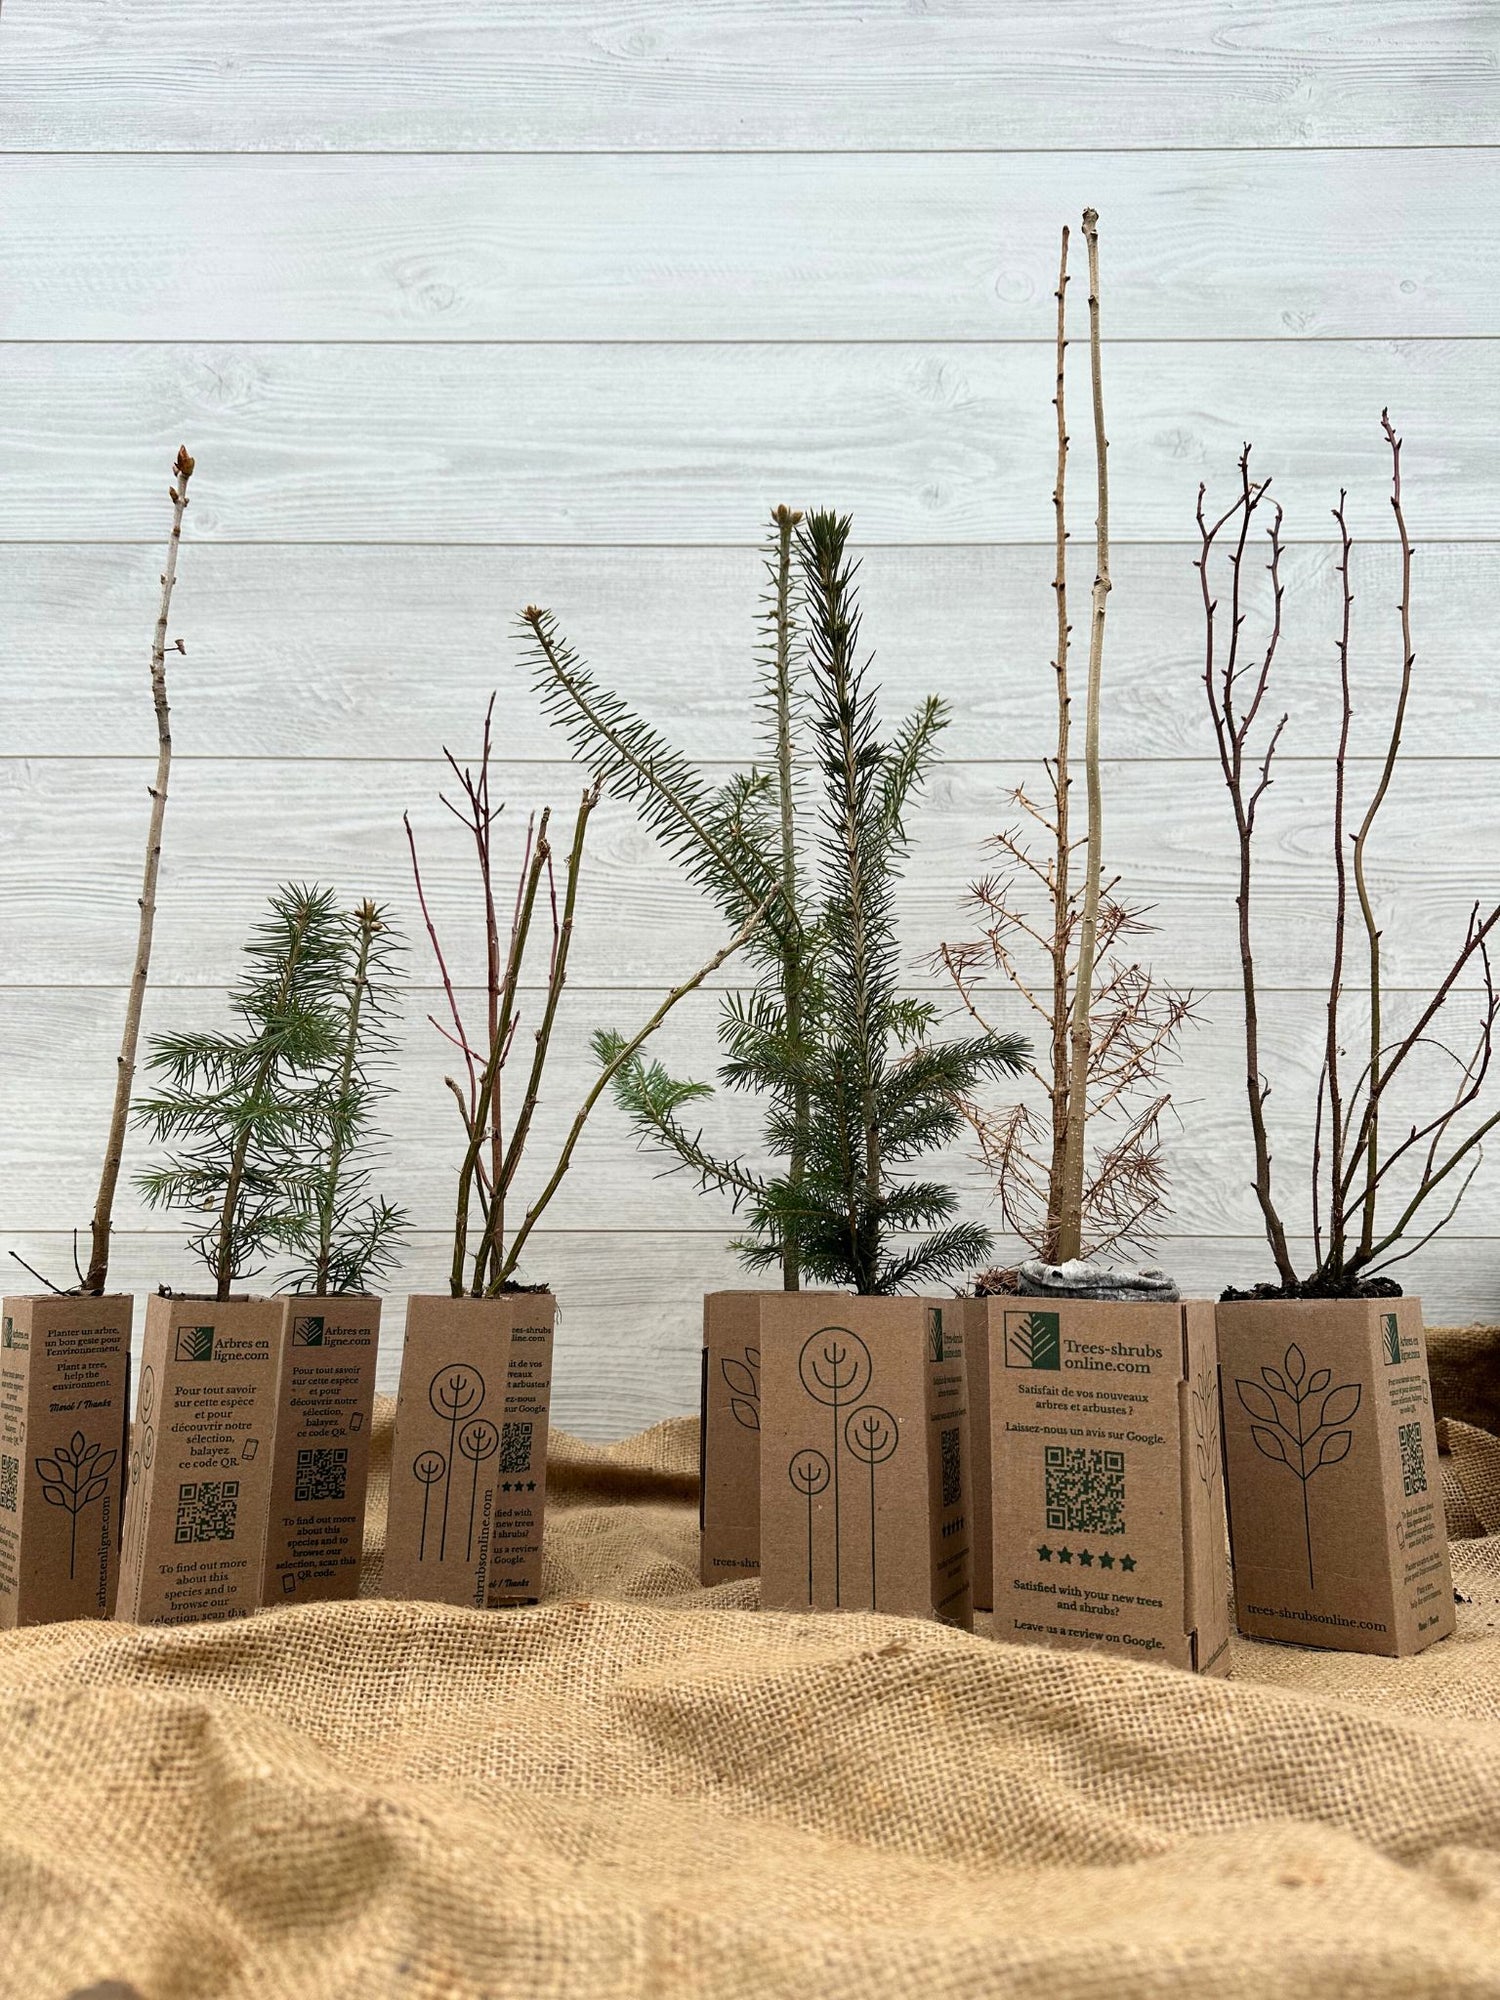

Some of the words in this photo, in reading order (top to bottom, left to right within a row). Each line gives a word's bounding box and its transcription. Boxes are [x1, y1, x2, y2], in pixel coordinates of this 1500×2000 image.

[47, 1329, 80, 1338] Planter
[324, 1327, 357, 1336] Arbres
[358, 1328, 371, 1336] en
[78, 1338, 100, 1347] geste
[100, 1337, 122, 1345] pour
[214, 1338, 253, 1349] Arbres
[255, 1340, 269, 1348] en
[323, 1337, 371, 1348] ligne.com
[1064, 1339, 1163, 1359] Trees-shrubs
[213, 1350, 269, 1363] ligne.com
[57, 1363, 80, 1371] Plant
[292, 1367, 314, 1375] Pour
[315, 1367, 333, 1375] tout
[334, 1366, 361, 1374] savoir
[1065, 1357, 1151, 1374] online.com
[64, 1372, 84, 1381] help
[85, 1371, 100, 1379] the
[330, 1377, 359, 1386] espèce
[174, 1386, 201, 1396] Pour
[203, 1386, 225, 1395] tout
[226, 1384, 257, 1394] savoir
[309, 1388, 318, 1396] et
[319, 1388, 342, 1397] pour
[1018, 1384, 1059, 1397] Satisfait
[1061, 1387, 1074, 1397] de
[1076, 1390, 1094, 1399] vos
[1096, 1390, 1149, 1403] nouveaux
[84, 1399, 112, 1409] Thanks
[174, 1399, 192, 1407] sur
[194, 1398, 218, 1407] cette
[221, 1397, 254, 1408] espèce
[290, 1398, 332, 1407] découvrir
[1036, 1399, 1068, 1411] arbres
[1070, 1403, 1081, 1412] et
[1082, 1402, 1127, 1415] arbustes
[302, 1407, 344, 1416] sélection,
[519, 1405, 547, 1414] Google.
[206, 1411, 233, 1421] pour
[171, 1422, 223, 1433] découvrir
[225, 1422, 252, 1431] notre
[305, 1419, 339, 1427] balayez
[308, 1428, 330, 1437] code
[1005, 1421, 1068, 1436] Laissez-nous
[1070, 1427, 1084, 1436] un
[1086, 1427, 1106, 1439] avis
[1108, 1431, 1125, 1440] sur
[1126, 1431, 1166, 1446] Google.
[186, 1434, 235, 1444] sélection,
[190, 1446, 230, 1457] balayez
[178, 1461, 191, 1469] ce
[192, 1458, 218, 1468] code
[221, 1458, 240, 1469] QR.
[282, 1517, 295, 1526] To
[296, 1516, 315, 1525] find
[316, 1516, 332, 1524] out
[297, 1527, 323, 1536] about
[324, 1525, 341, 1534] this
[498, 1530, 529, 1538] shrubs?
[288, 1537, 319, 1549] species
[321, 1536, 338, 1545] and
[96, 1496, 111, 1608] arbresenligne.com
[292, 1549, 325, 1558] browse
[326, 1548, 342, 1556] our
[511, 1544, 538, 1553] review
[275, 1560, 318, 1570] selection,
[319, 1559, 339, 1567] scan
[340, 1556, 356, 1565] this
[495, 1555, 526, 1565] Google.
[159, 1565, 174, 1574] To
[176, 1562, 197, 1573] find
[199, 1562, 218, 1571] out
[219, 1560, 248, 1568] more
[176, 1575, 206, 1586] about
[209, 1572, 229, 1582] this
[297, 1570, 312, 1580] QR
[313, 1568, 336, 1577] code.
[505, 1579, 530, 1587] Thanks
[164, 1587, 202, 1600] species
[204, 1584, 225, 1596] and
[227, 1585, 237, 1593] to
[1013, 1580, 1057, 1594] Satisfied
[1059, 1585, 1082, 1597] with
[1084, 1590, 1110, 1602] your
[1112, 1593, 1135, 1604] new
[1136, 1595, 1163, 1608] trees
[170, 1601, 209, 1611] browse
[210, 1599, 230, 1607] our
[1057, 1600, 1077, 1611] and
[1079, 1602, 1120, 1616] shrubs?
[201, 1611, 225, 1621] scan
[227, 1608, 247, 1618] this
[1247, 1604, 1388, 1633] trees-shrubsonline.com
[1014, 1619, 1044, 1632] Leave
[1046, 1625, 1058, 1635] us
[1060, 1627, 1067, 1636] a
[1068, 1627, 1104, 1641] review
[1105, 1632, 1121, 1643] on
[1122, 1634, 1165, 1650] Google.
